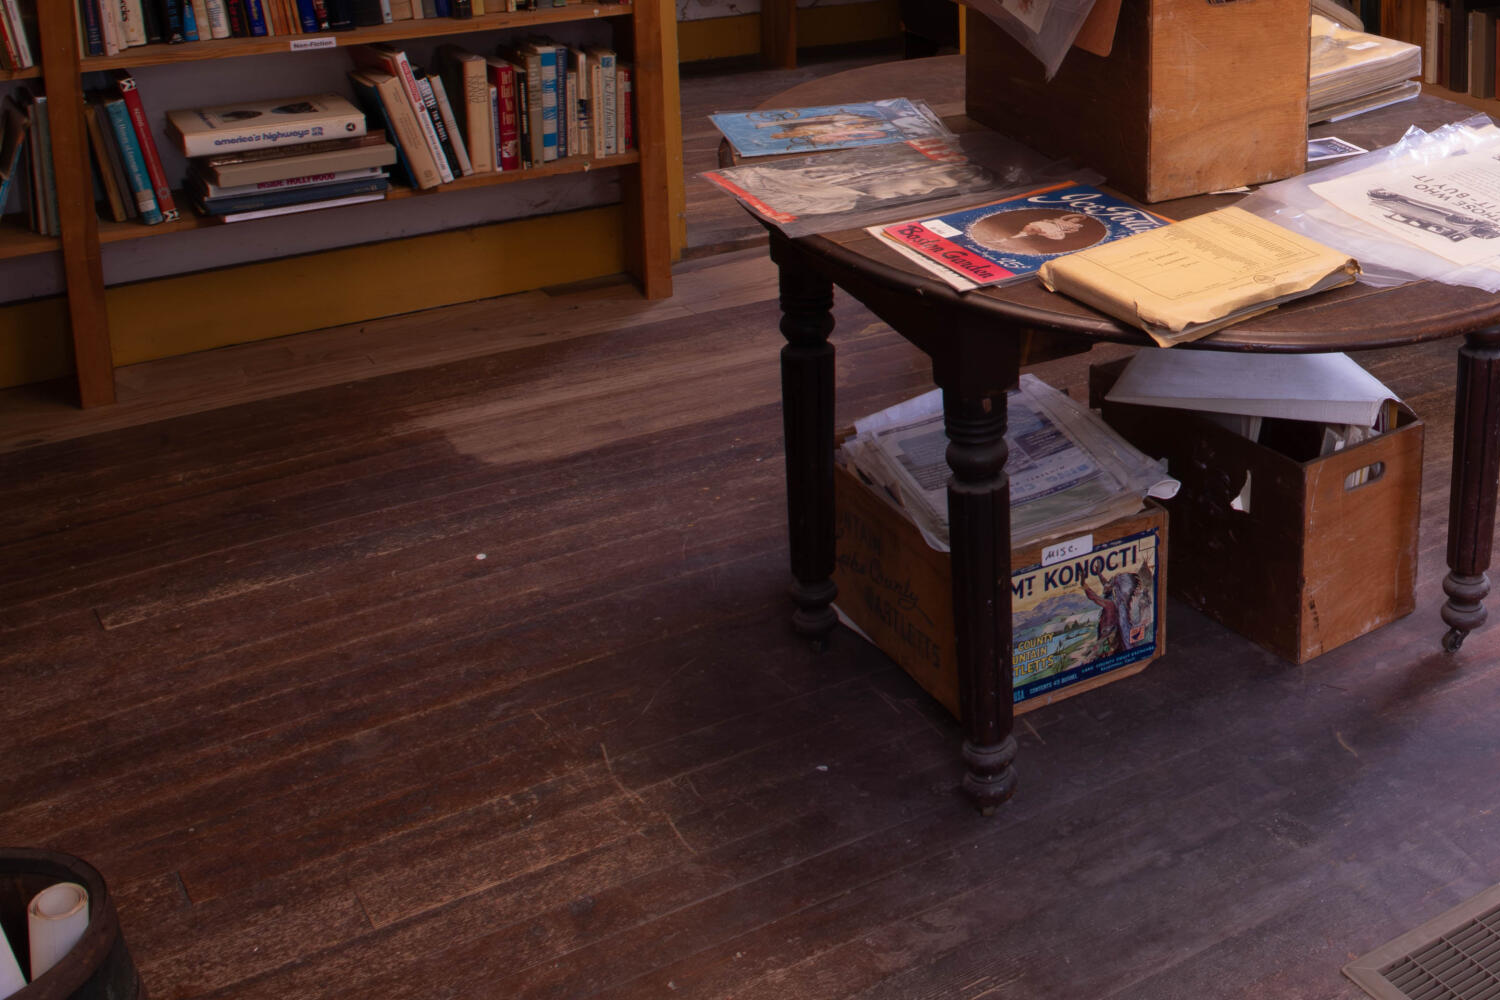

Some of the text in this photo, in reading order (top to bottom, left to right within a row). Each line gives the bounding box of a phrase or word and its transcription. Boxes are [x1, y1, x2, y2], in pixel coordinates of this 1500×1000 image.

[1412, 174, 1433, 187] IT
[1413, 183, 1450, 202] WHO
[899, 224, 994, 281] Boston Garden
[1044, 545, 1137, 592] KONOCTI
[1018, 633, 1054, 651] COUNTY
[1012, 647, 1047, 665] UNTAIN
